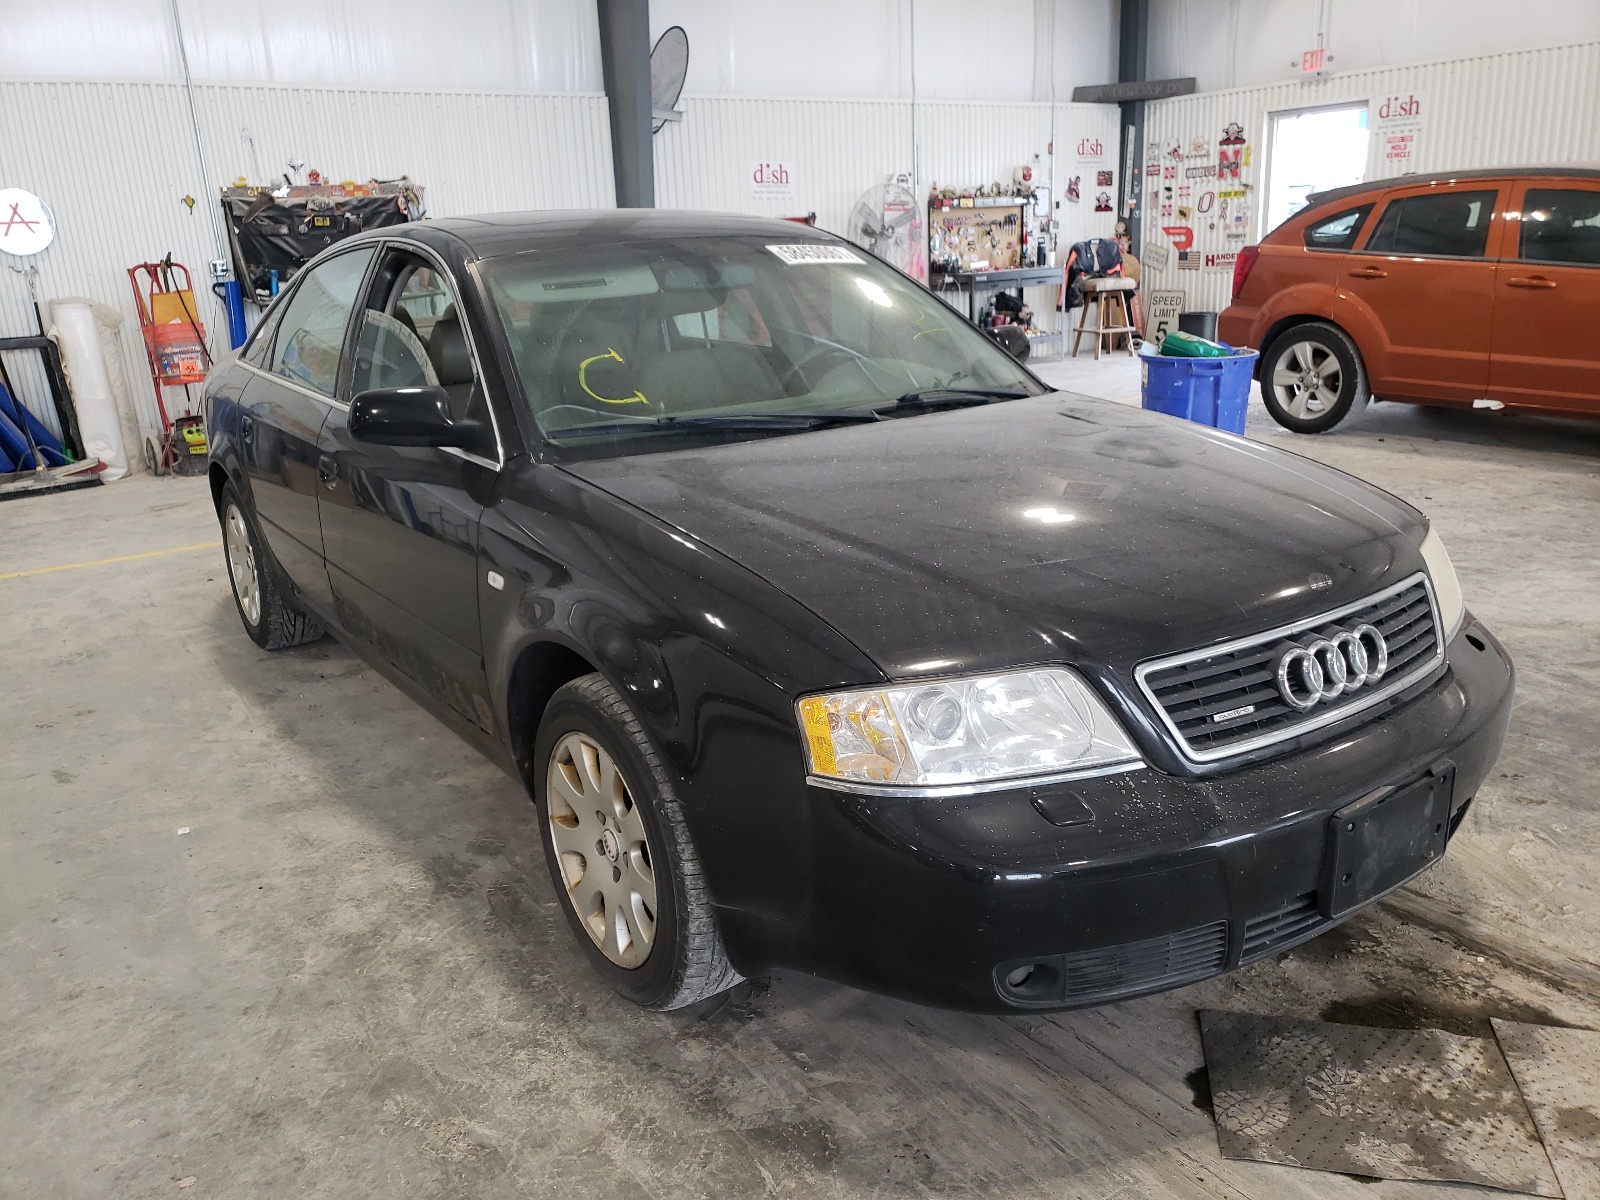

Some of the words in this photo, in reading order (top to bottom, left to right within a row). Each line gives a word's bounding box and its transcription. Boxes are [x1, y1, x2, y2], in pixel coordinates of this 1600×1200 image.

[1302, 48, 1325, 71] EXIT
[1379, 95, 1420, 119] dish
[1077, 138, 1103, 156] dish
[753, 163, 789, 184] dish
[1205, 252, 1239, 267] HANDE
[1151, 295, 1182, 306] SPEED
[1153, 308, 1177, 319] LIMIT
[1155, 321, 1168, 343] 5
[1218, 706, 1251, 721] quattro
